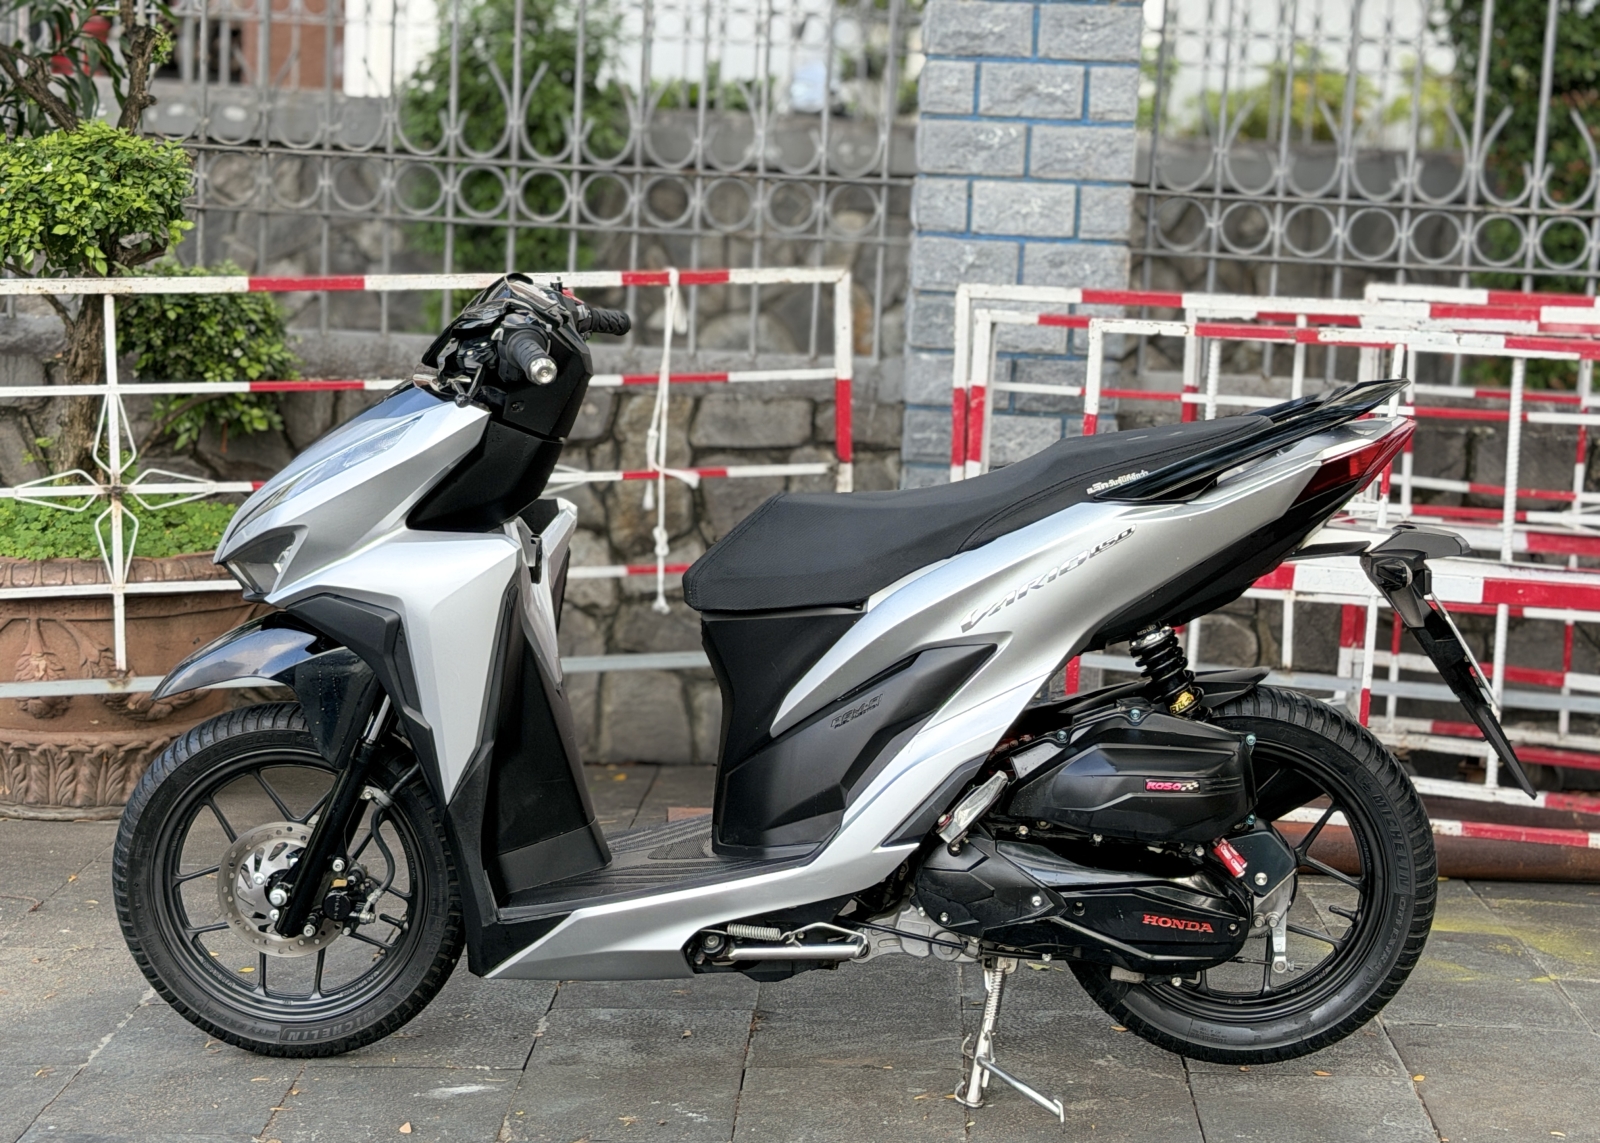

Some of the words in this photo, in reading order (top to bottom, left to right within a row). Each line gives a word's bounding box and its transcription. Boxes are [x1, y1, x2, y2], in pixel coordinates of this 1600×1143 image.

[960, 550, 1089, 633] VARIO
[1089, 524, 1136, 558] 150
[1146, 781, 1181, 790] KOSO
[1372, 794, 1411, 888] MICHELIN
[1142, 913, 1214, 933] HONDA
[287, 1008, 376, 1042] MICHELIN
